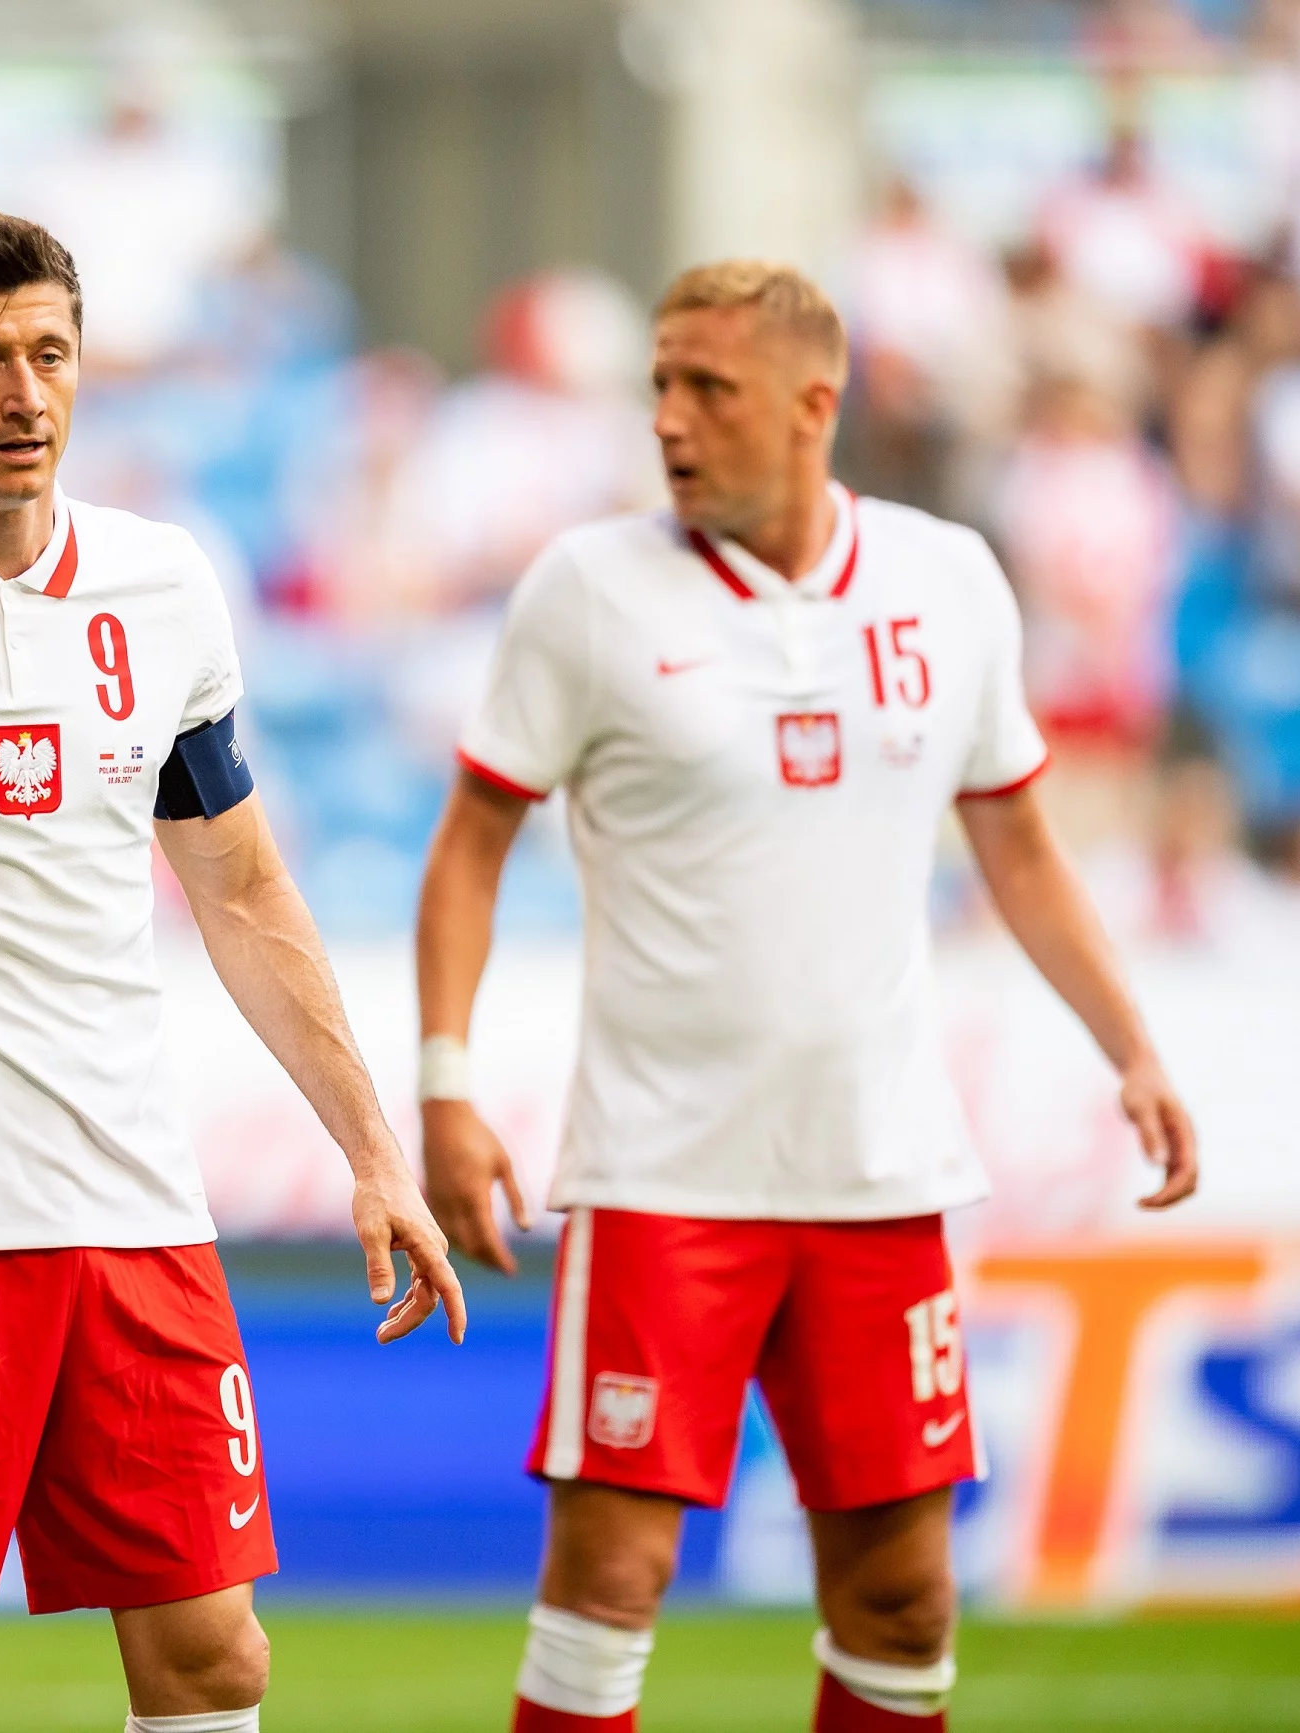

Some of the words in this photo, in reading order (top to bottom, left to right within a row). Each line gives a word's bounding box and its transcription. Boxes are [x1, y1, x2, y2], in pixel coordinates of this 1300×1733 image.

[87, 612, 136, 721] 9
[862, 615, 932, 710] 15
[98, 766, 118, 774] POLAND
[123, 765, 141, 773] ICELAND
[903, 1290, 962, 1402] 15
[219, 1362, 257, 1477] 9
